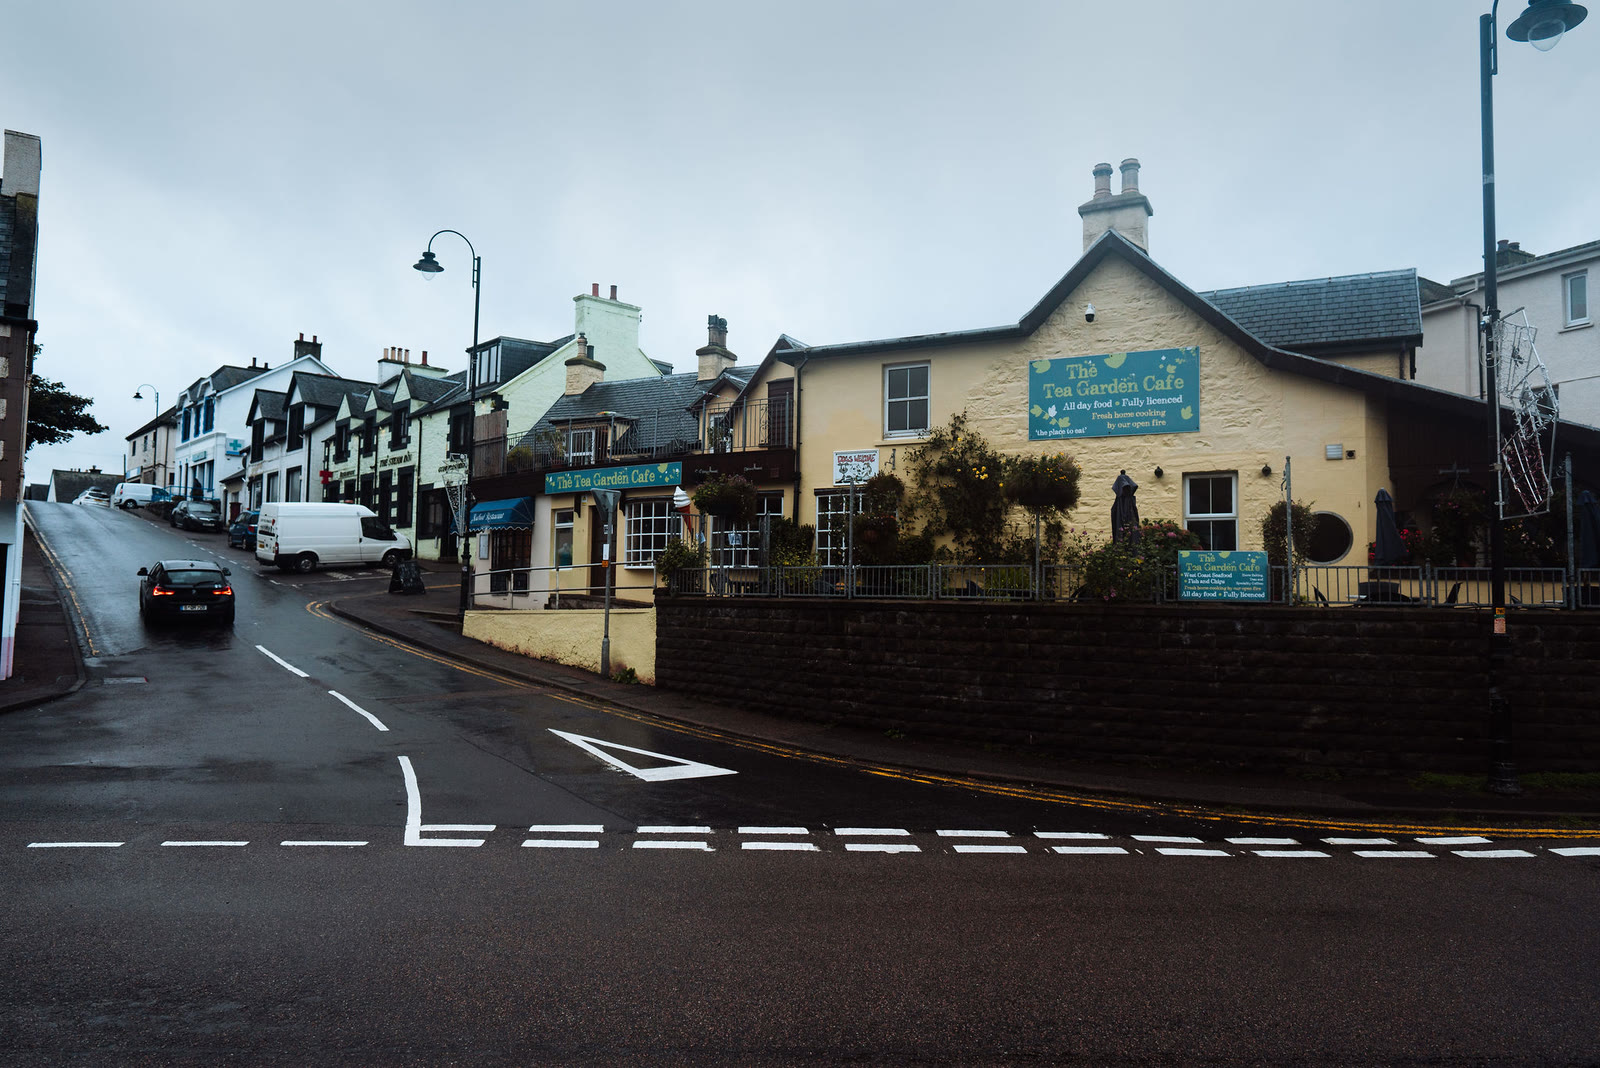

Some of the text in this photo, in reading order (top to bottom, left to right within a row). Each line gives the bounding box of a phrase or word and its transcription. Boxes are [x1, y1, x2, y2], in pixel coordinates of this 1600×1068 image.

[1066, 364, 1097, 379] The
[1043, 374, 1184, 399] Tea Garden Cafe
[1063, 395, 1182, 410] All day food Fully licenced
[1136, 410, 1166, 418] cooking
[854, 454, 876, 462] WELCOME
[557, 469, 655, 489] The Tea Garden Cafe
[1186, 563, 1260, 571] Tea Garden Cafe
